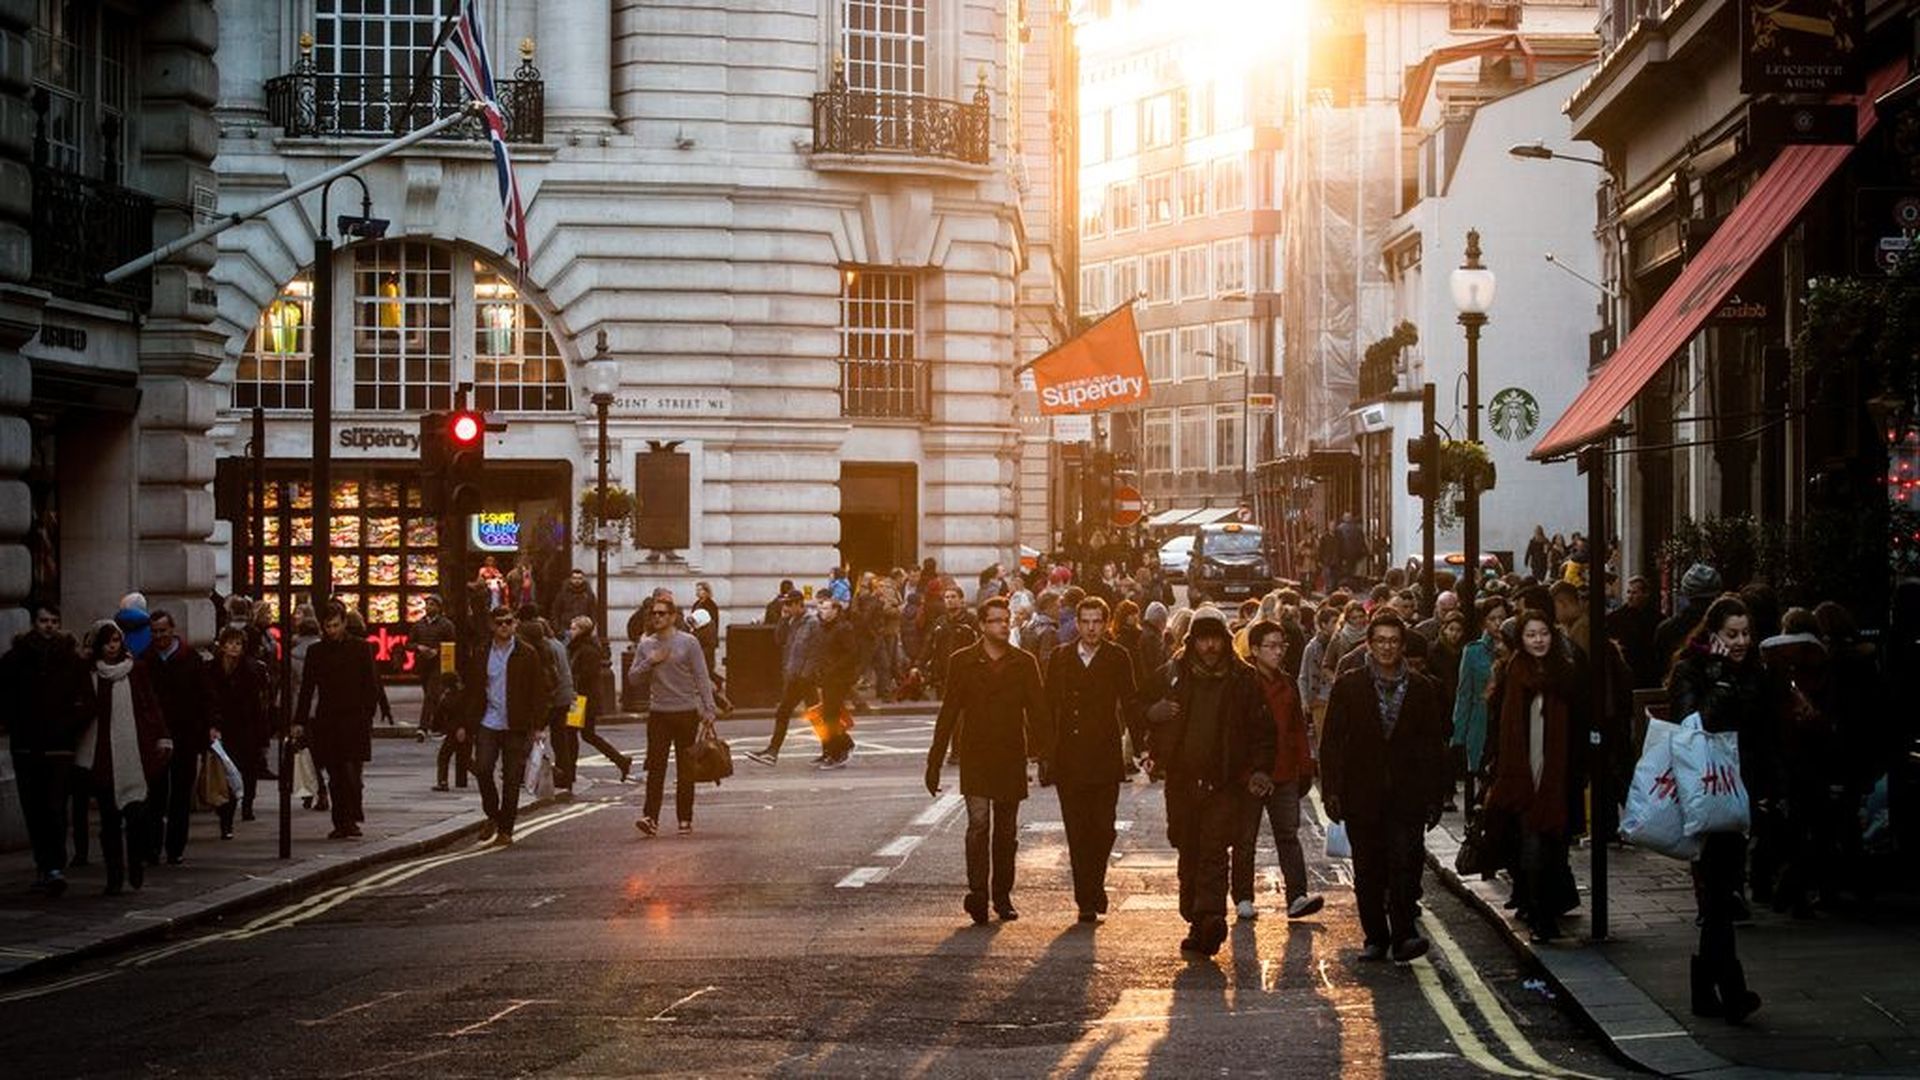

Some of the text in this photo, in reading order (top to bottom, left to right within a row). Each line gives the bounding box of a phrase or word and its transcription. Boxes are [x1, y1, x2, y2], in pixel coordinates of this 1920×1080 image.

[1765, 64, 1843, 76] LEICESTER
[1042, 374, 1143, 408] Superdry
[658, 399, 701, 409] STREET
[340, 429, 420, 452] Superdry
